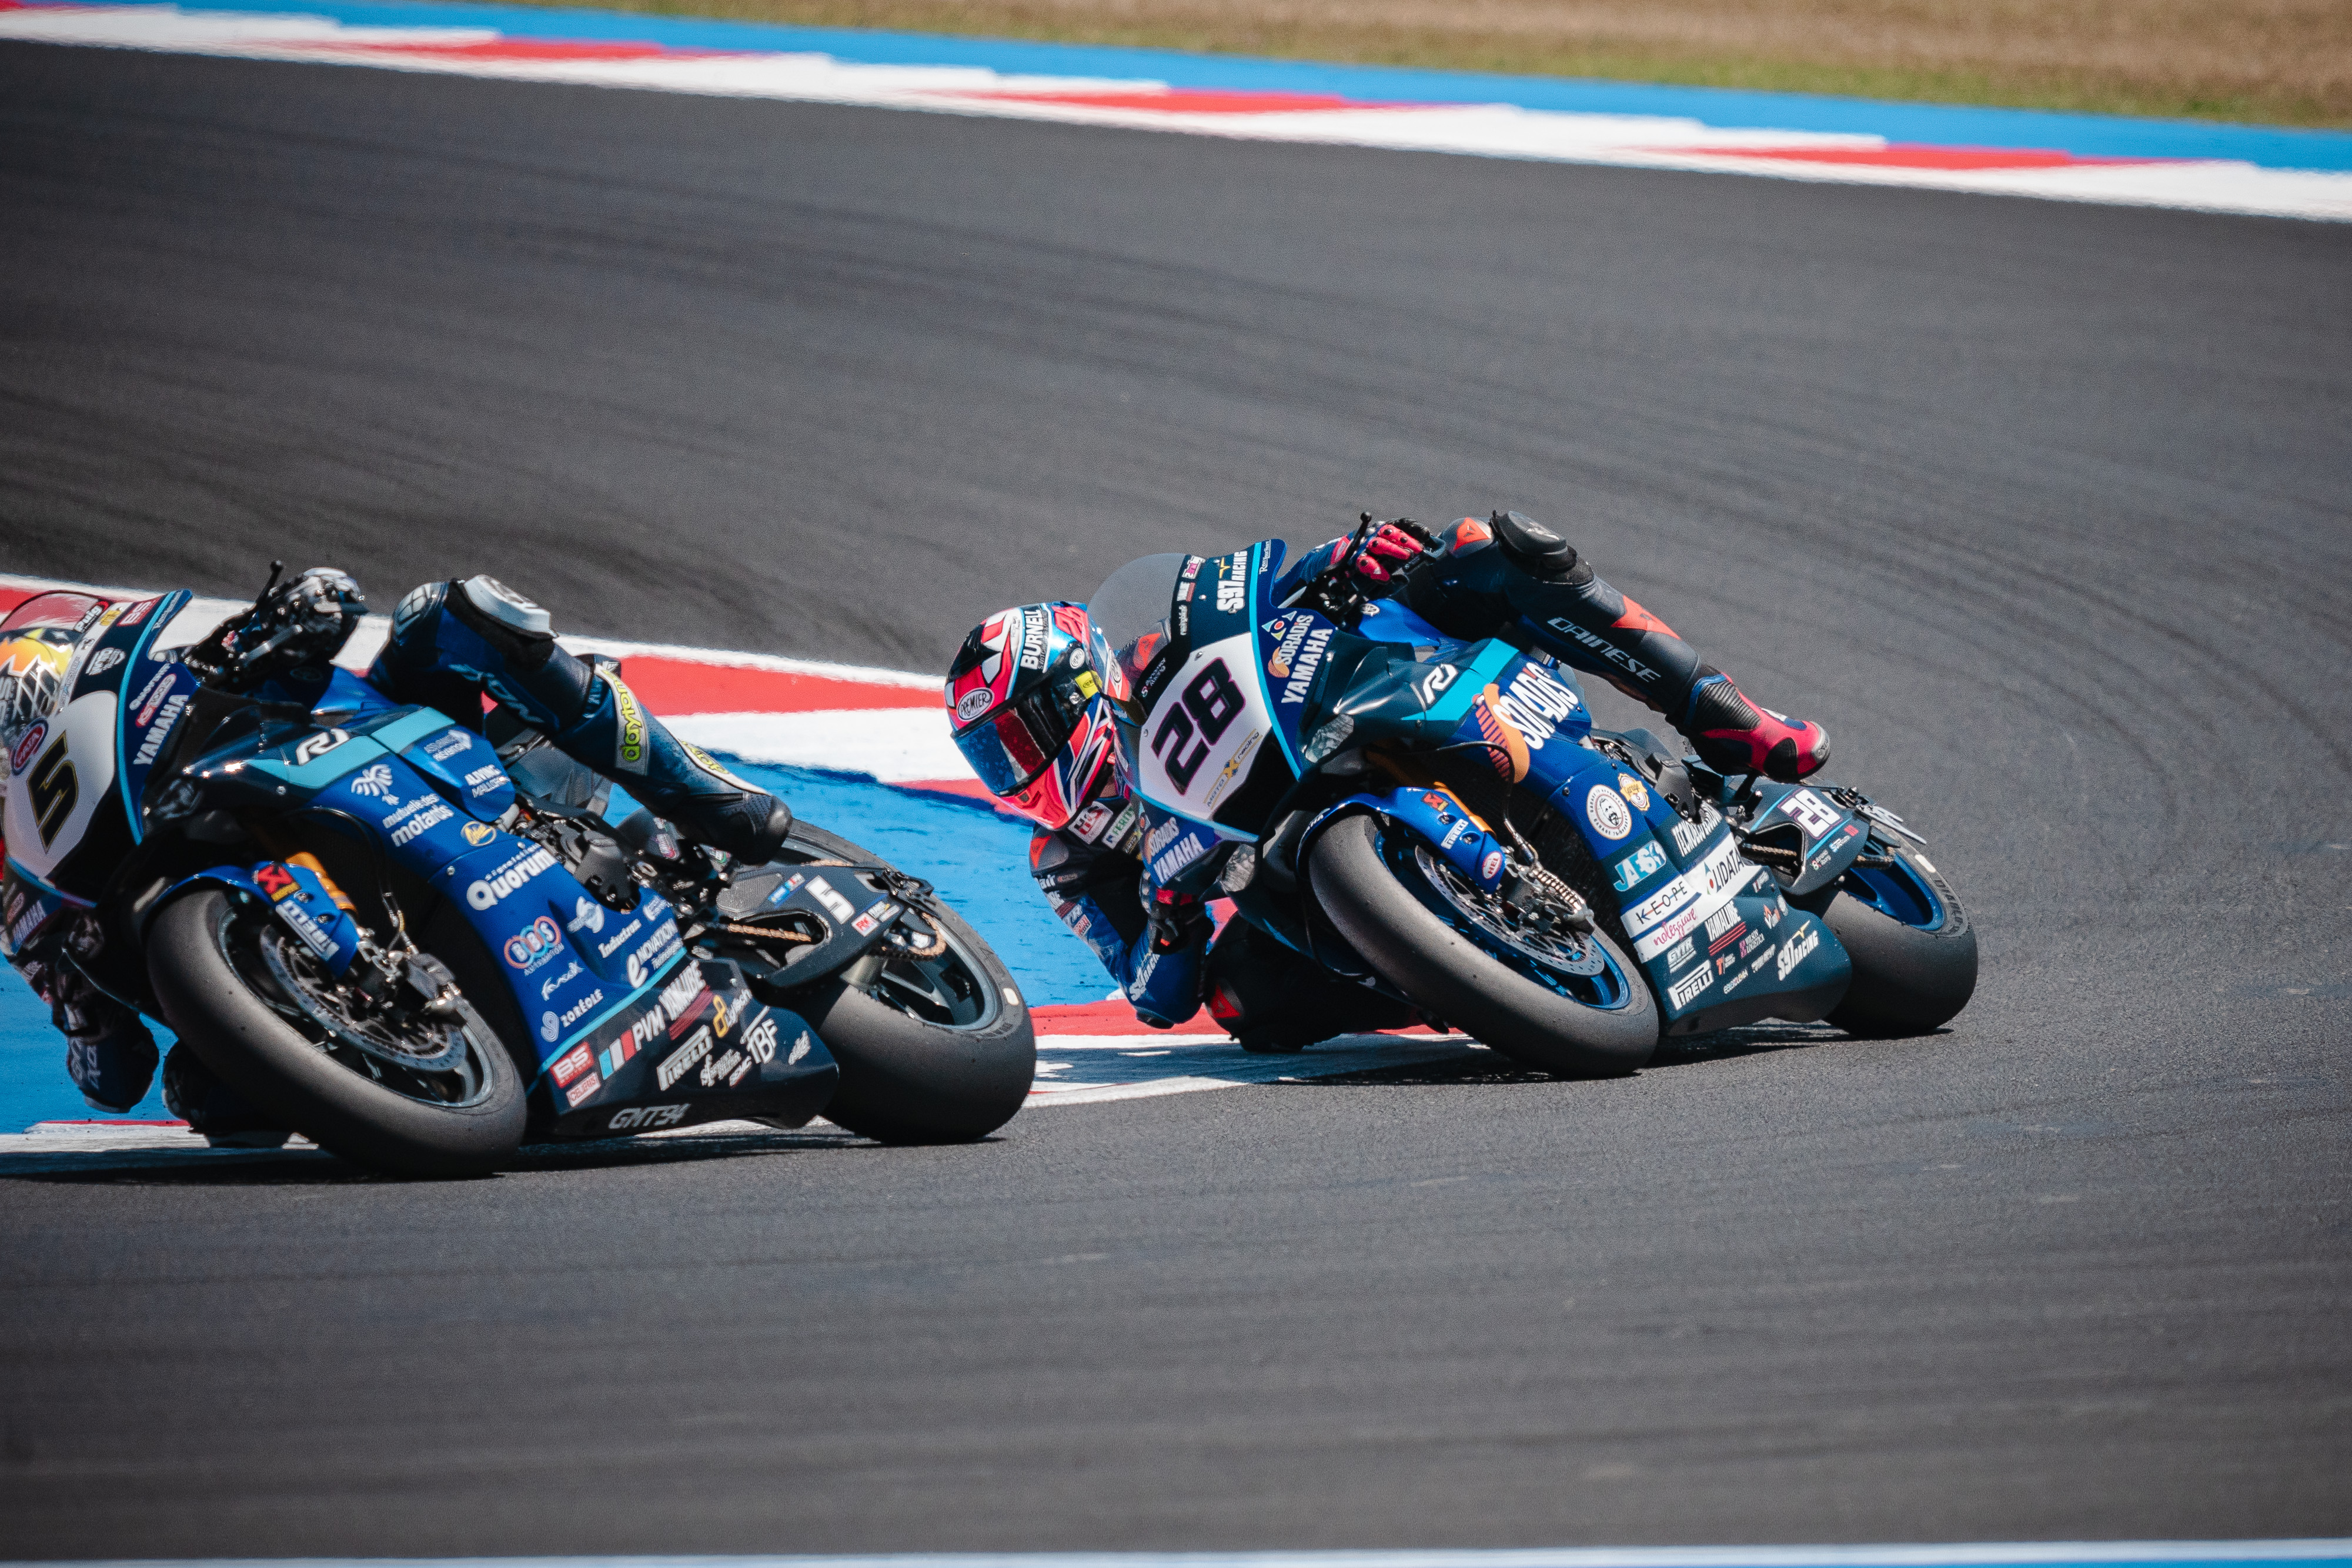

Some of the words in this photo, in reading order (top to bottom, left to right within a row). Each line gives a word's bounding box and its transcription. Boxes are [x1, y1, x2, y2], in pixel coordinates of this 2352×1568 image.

[1217, 580, 1245, 611] S97
[1231, 550, 1248, 581] RACING
[75, 604, 103, 633] Puig
[1020, 609, 1044, 670] BURNELL
[1281, 628, 1333, 703] YAMAHA
[1546, 616, 1662, 683] DAINESE
[133, 695, 190, 765] YAMAHA
[960, 690, 992, 719] PREMIER
[1151, 657, 1246, 796] 28
[26, 729, 79, 854] 5
[1780, 788, 1841, 838] 28
[466, 847, 559, 911] Quorum
[1152, 833, 1204, 884] YAMAHA
[1488, 857, 1499, 875] HEL
[805, 874, 856, 925] 5
[1705, 900, 1742, 942] YAMALUBE
[1667, 937, 1693, 965] GYTR
[1793, 930, 1819, 970] RACING
[1668, 959, 1715, 1011] PIRELLI
[632, 1004, 666, 1051] PVM
[553, 1046, 589, 1079] BS
[656, 1024, 714, 1092] PIRELLI
[608, 1103, 691, 1130] GMT94
